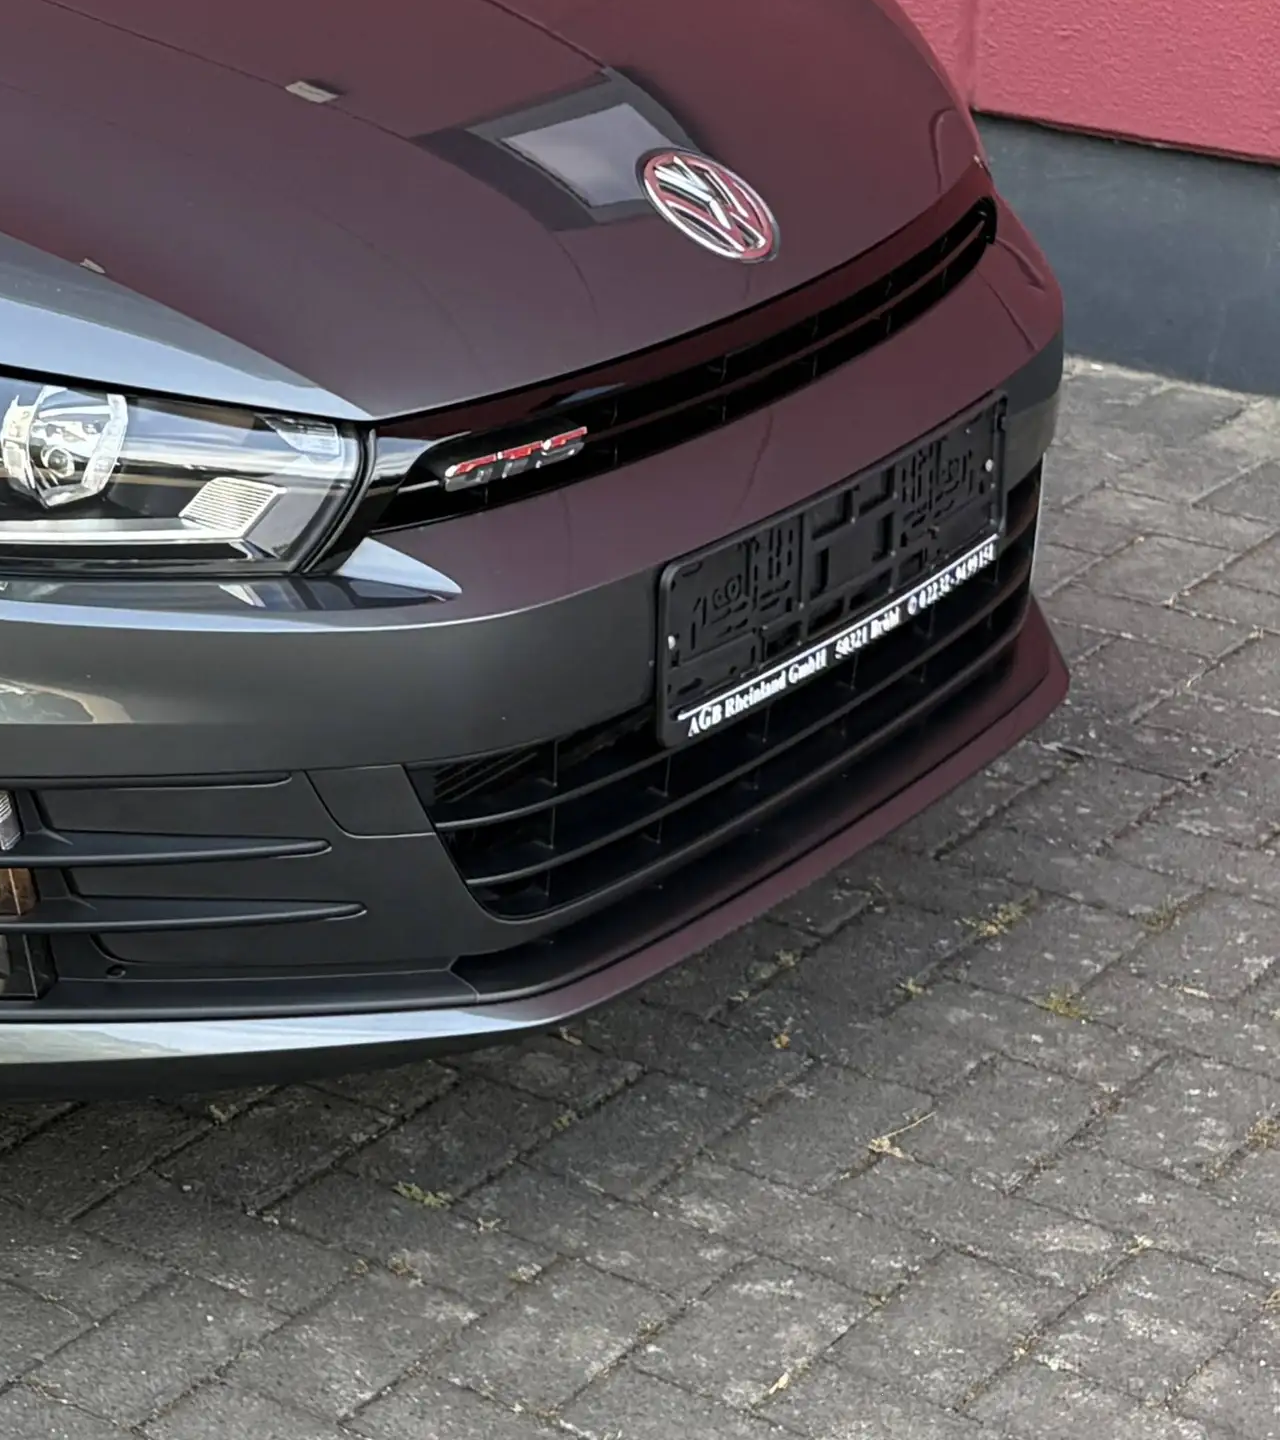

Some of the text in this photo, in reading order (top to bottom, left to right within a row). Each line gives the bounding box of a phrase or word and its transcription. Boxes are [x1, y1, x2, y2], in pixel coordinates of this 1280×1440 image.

[688, 705, 723, 737] AGB
[724, 670, 787, 718] Rheinland
[788, 648, 828, 684] GmbH
